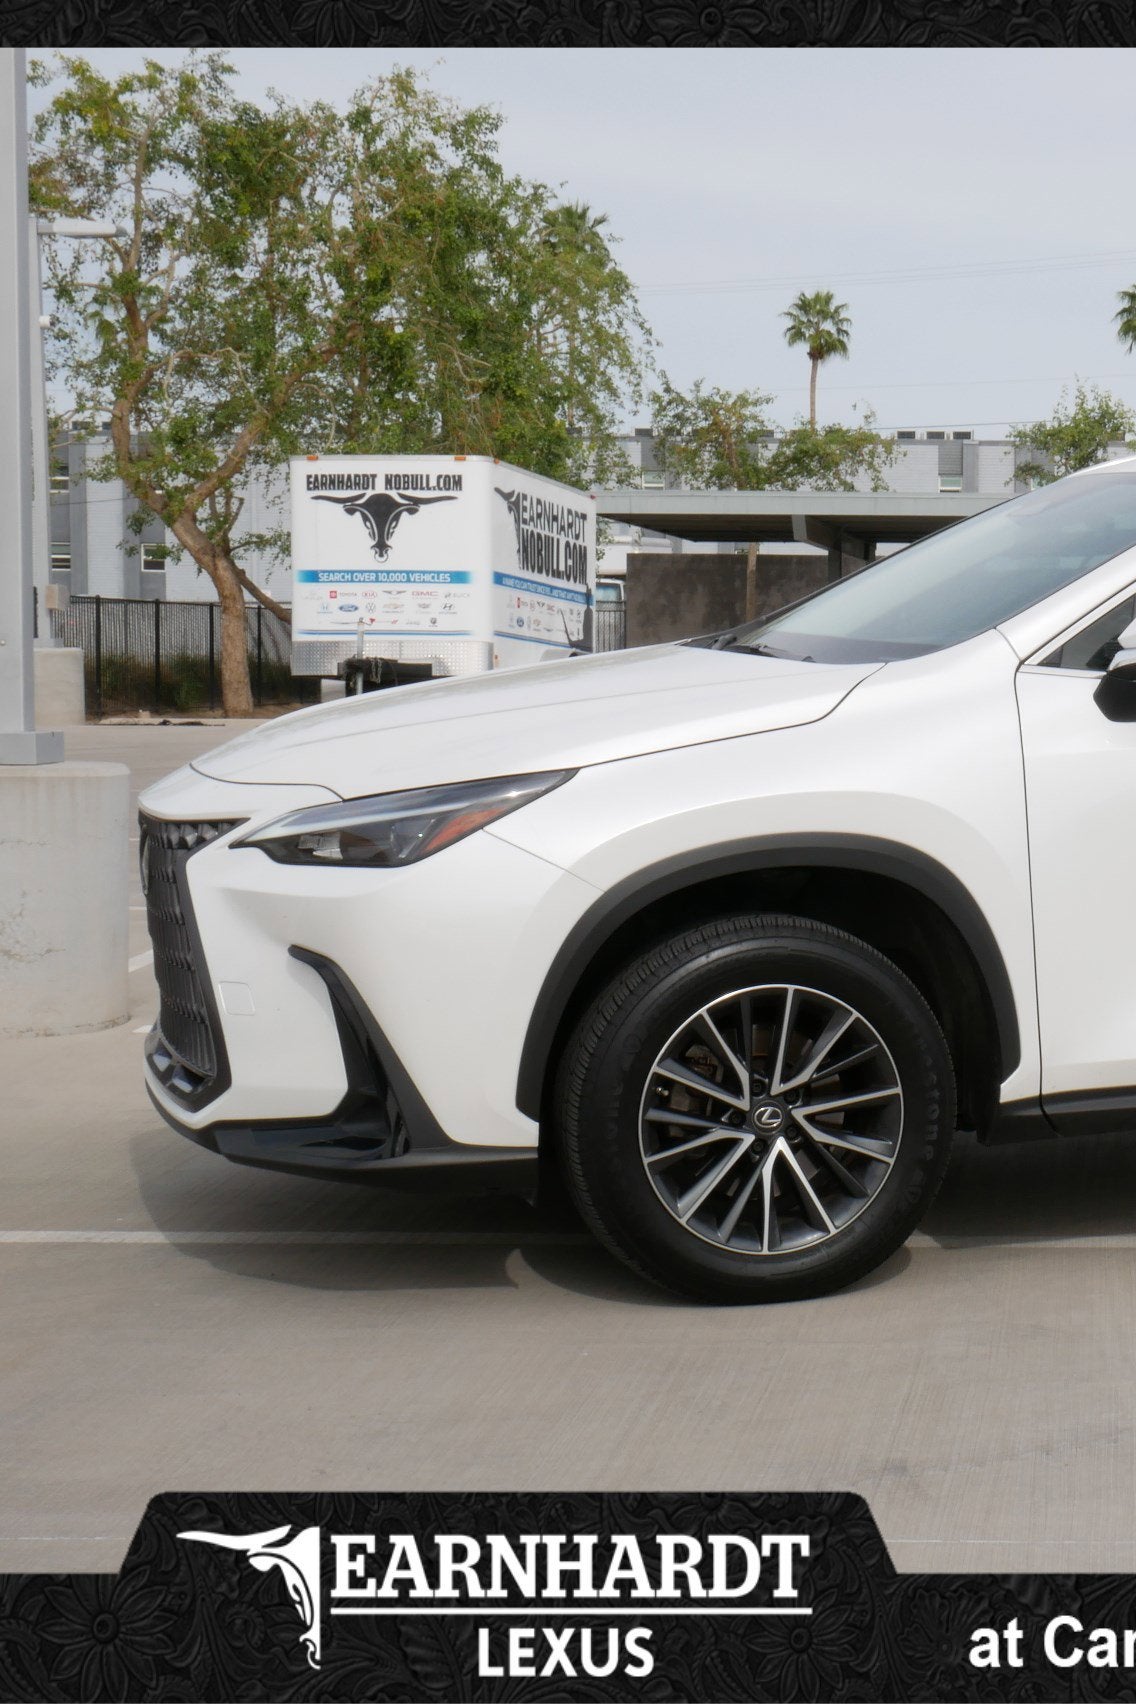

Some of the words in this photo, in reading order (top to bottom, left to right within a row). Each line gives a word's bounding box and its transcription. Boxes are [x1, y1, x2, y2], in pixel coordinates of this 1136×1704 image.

[306, 473, 377, 491] EARNHARDT
[385, 473, 463, 491] NOBULL.COM
[521, 493, 587, 542] EARNHARDT
[521, 527, 587, 584] NOBULL.COM
[318, 573, 350, 582] SEARCH
[353, 573, 375, 582] OVER
[378, 573, 407, 583] 10,000
[410, 573, 451, 583] VEHICLES
